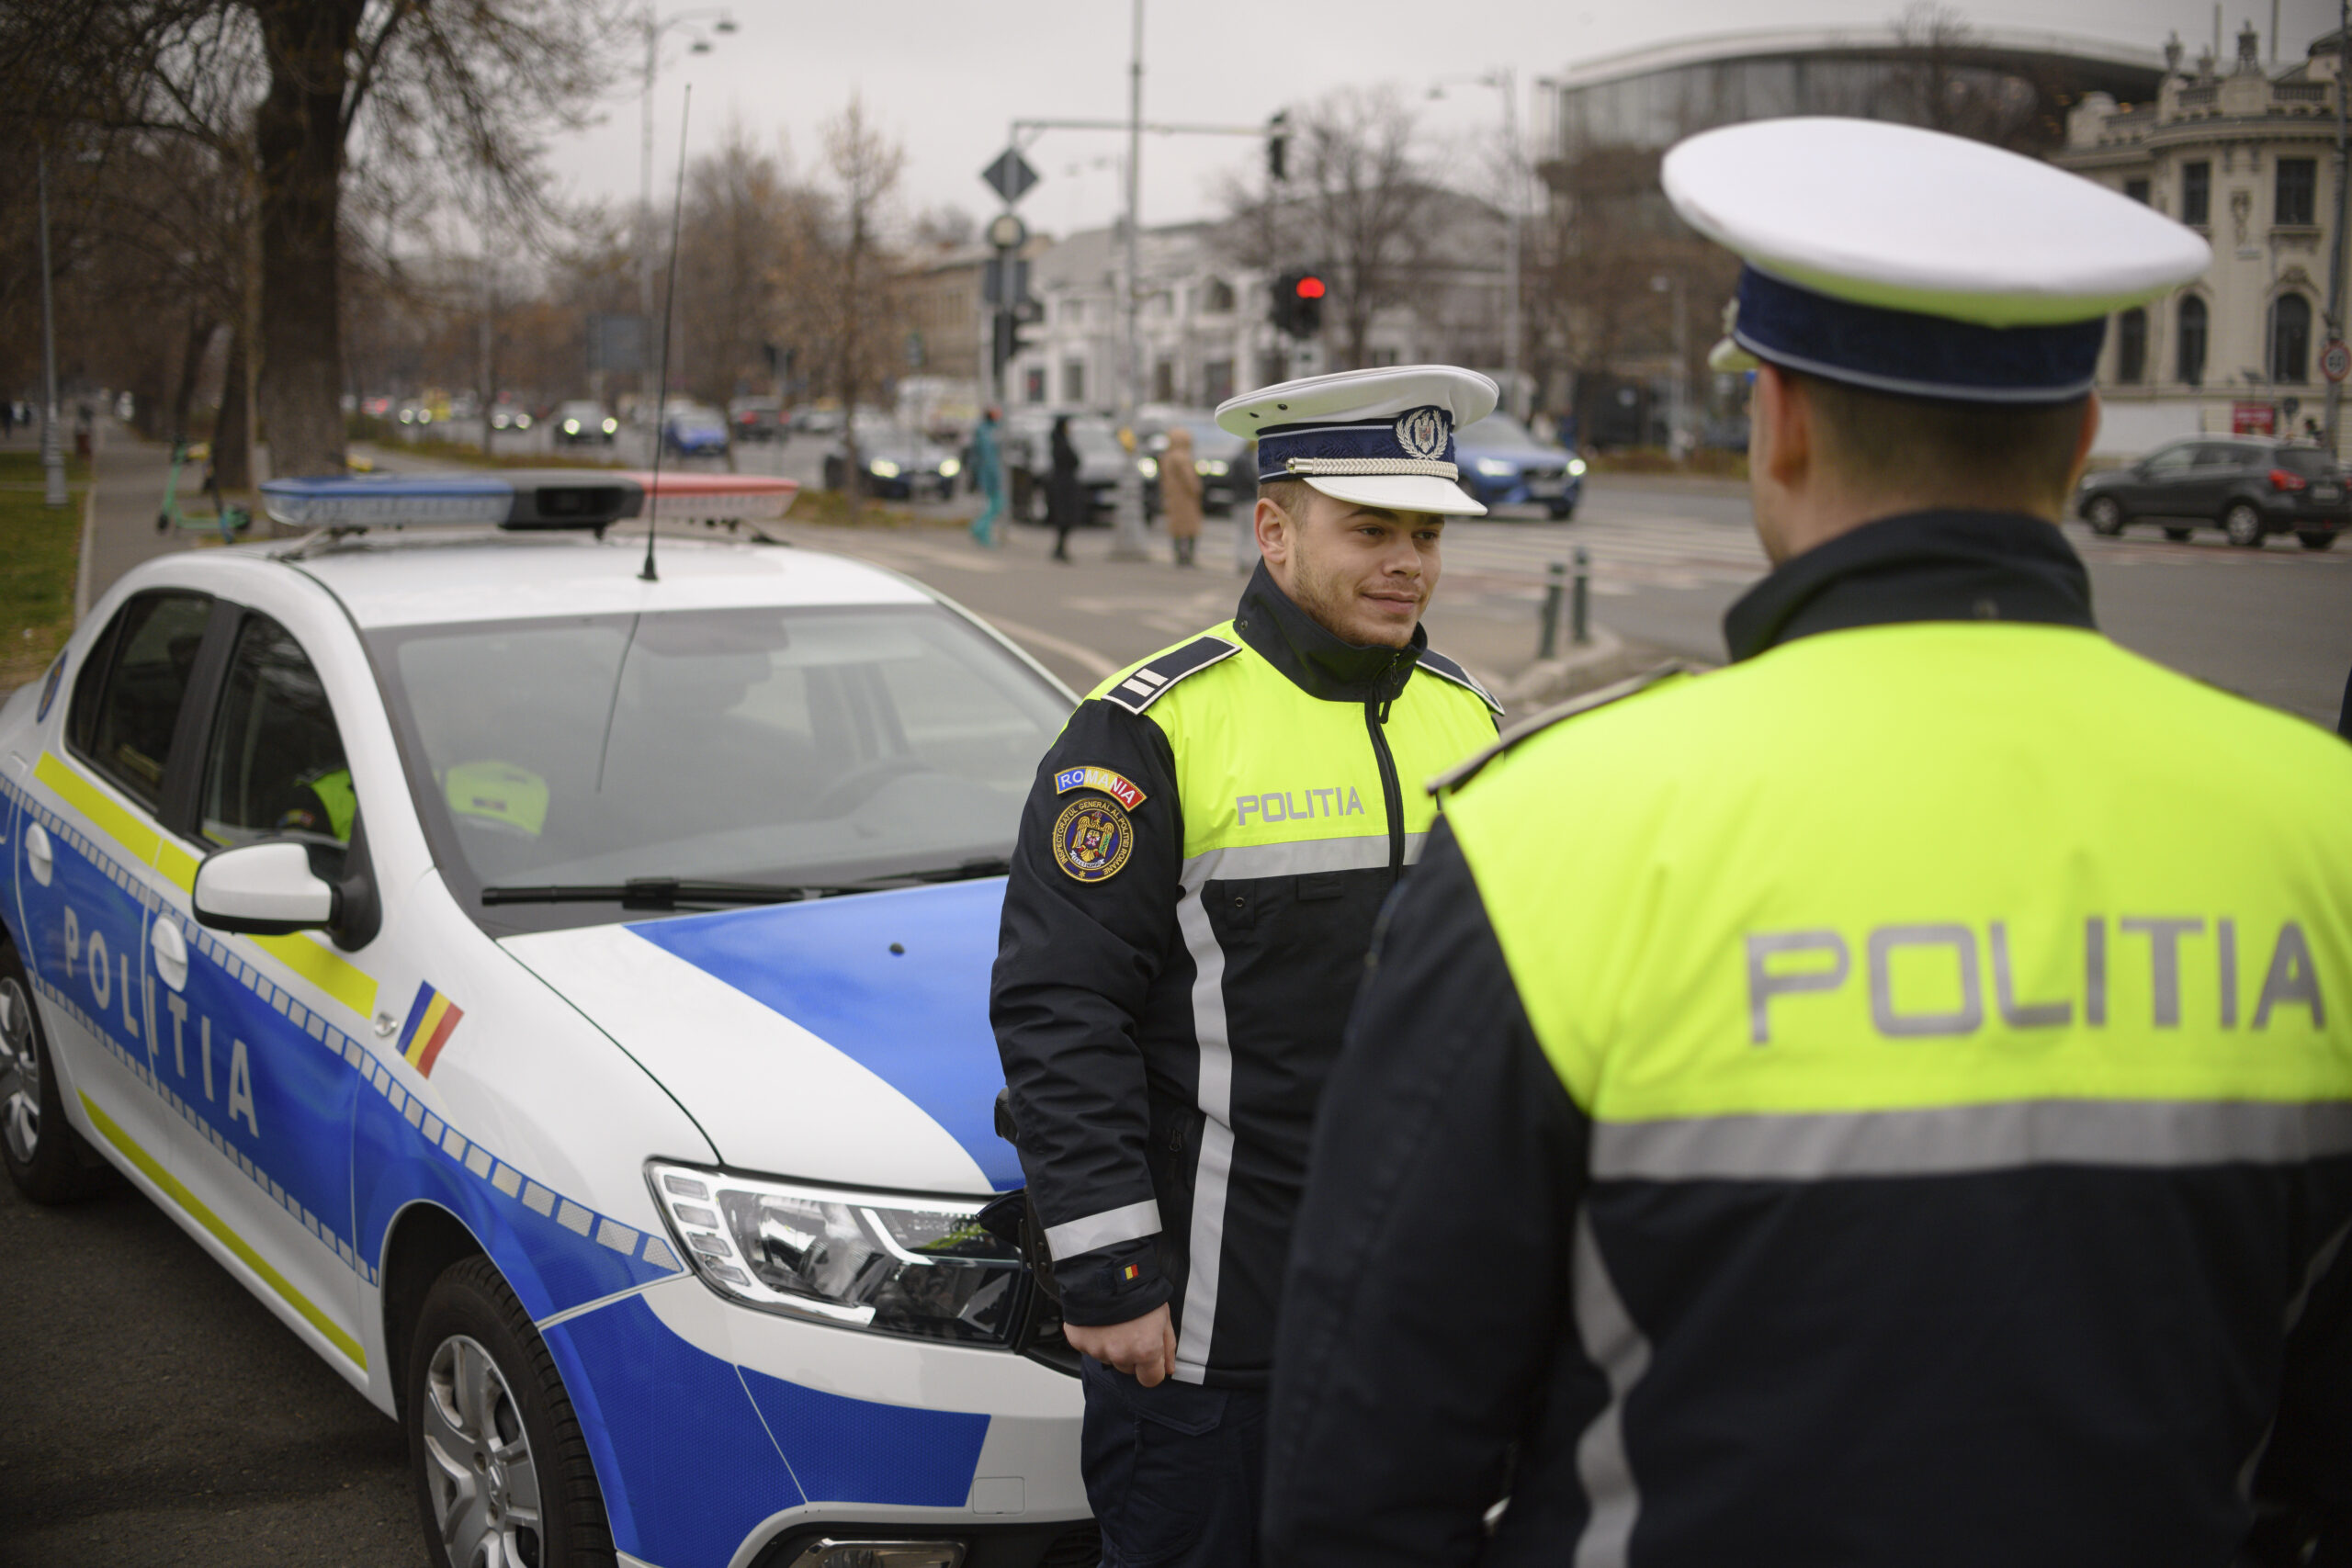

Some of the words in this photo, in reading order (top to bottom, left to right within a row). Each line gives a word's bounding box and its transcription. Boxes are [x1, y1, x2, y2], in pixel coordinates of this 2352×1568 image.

[1060, 770, 1136, 804] ROMANIA
[1079, 801, 1111, 812] GENERAL
[1111, 808, 1120, 818] AL
[1236, 786, 1365, 826] POLITIA
[1057, 808, 1079, 864] INSPECTORATUL
[1103, 848, 1128, 875] ROMANE
[1746, 916, 2326, 1046] POLITIA
[63, 905, 261, 1139] POLITIA
